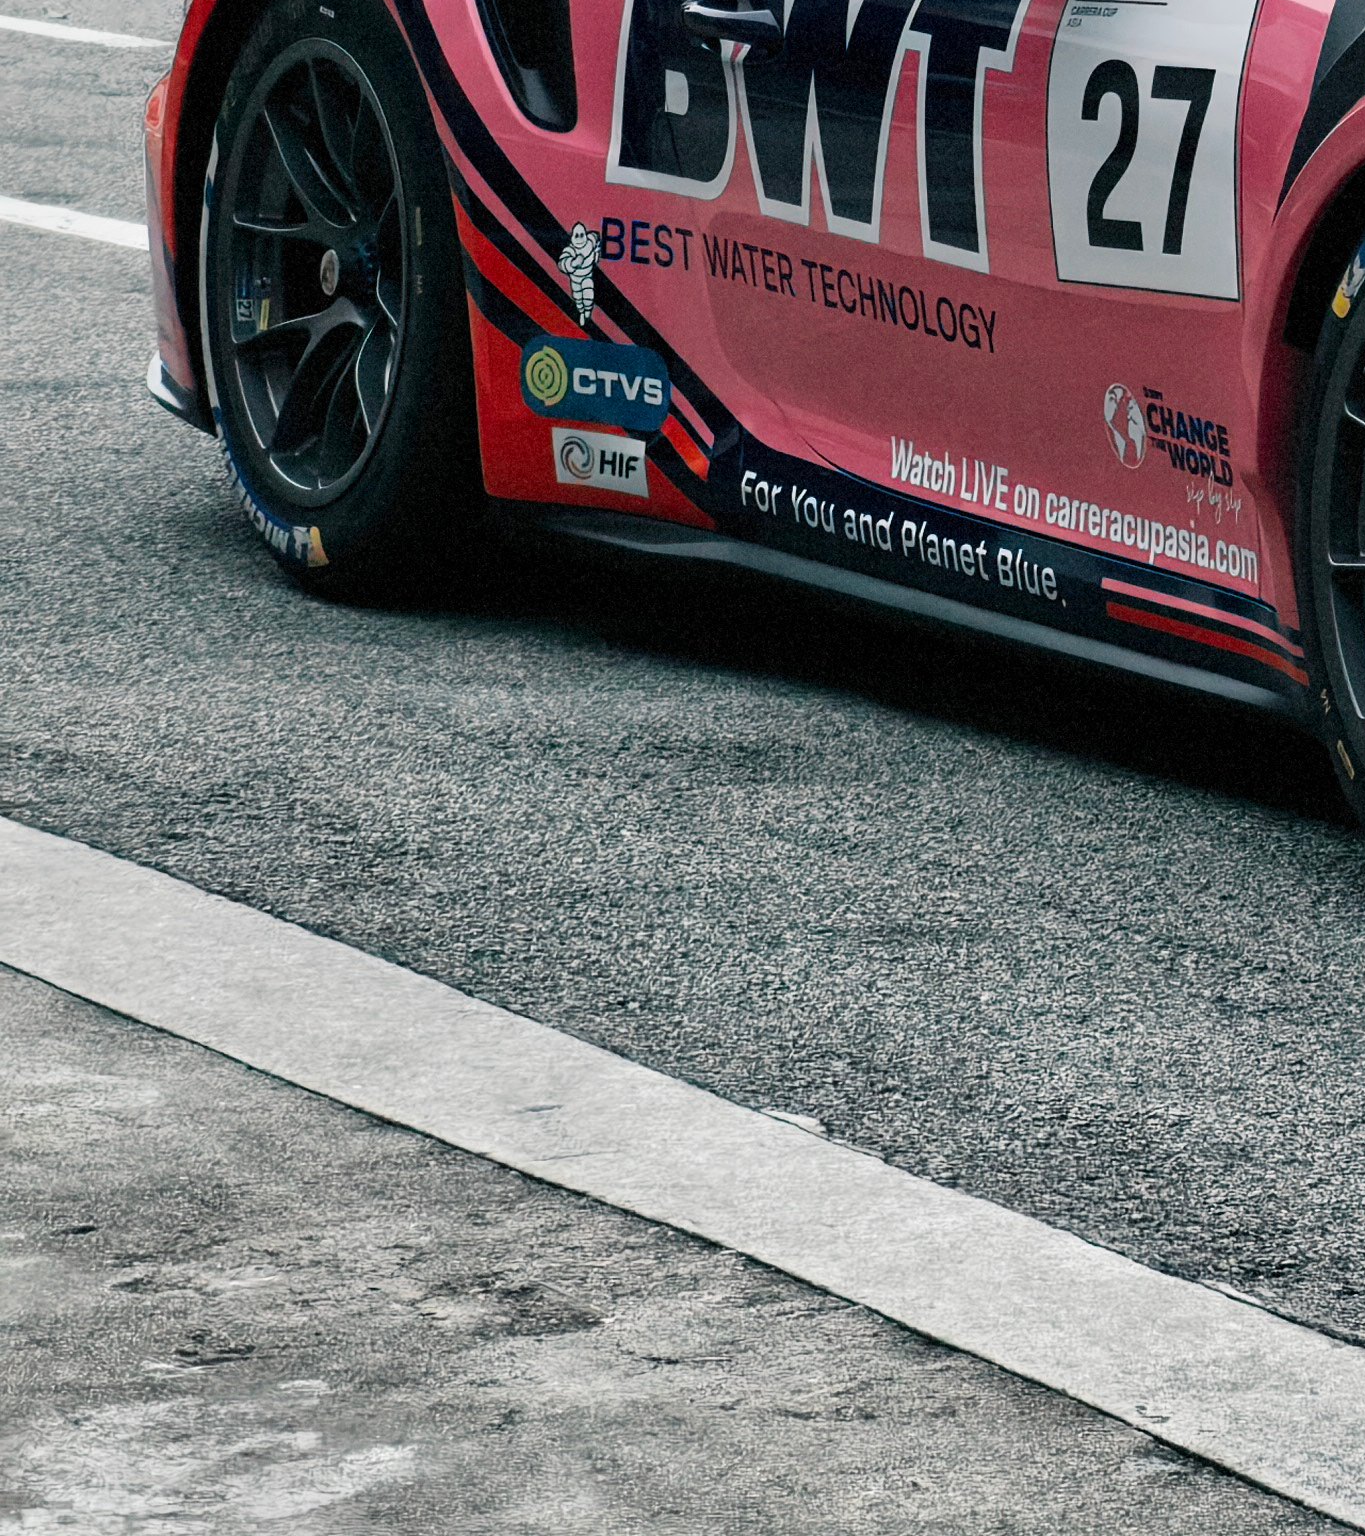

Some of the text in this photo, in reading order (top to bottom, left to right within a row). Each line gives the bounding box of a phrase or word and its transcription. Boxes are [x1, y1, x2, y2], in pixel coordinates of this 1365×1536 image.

[1081, 59, 1216, 255] 27
[601, 217, 997, 354] BEST WATER TECHNOLOGY
[573, 367, 663, 405] CTVS
[1146, 403, 1231, 457] CHANGE
[600, 450, 639, 479] HIF
[891, 436, 1258, 584] Watch LIVE on carreracupasia.com
[1167, 441, 1233, 487] WORLD
[741, 470, 1067, 608] For You and Planet Blue.
